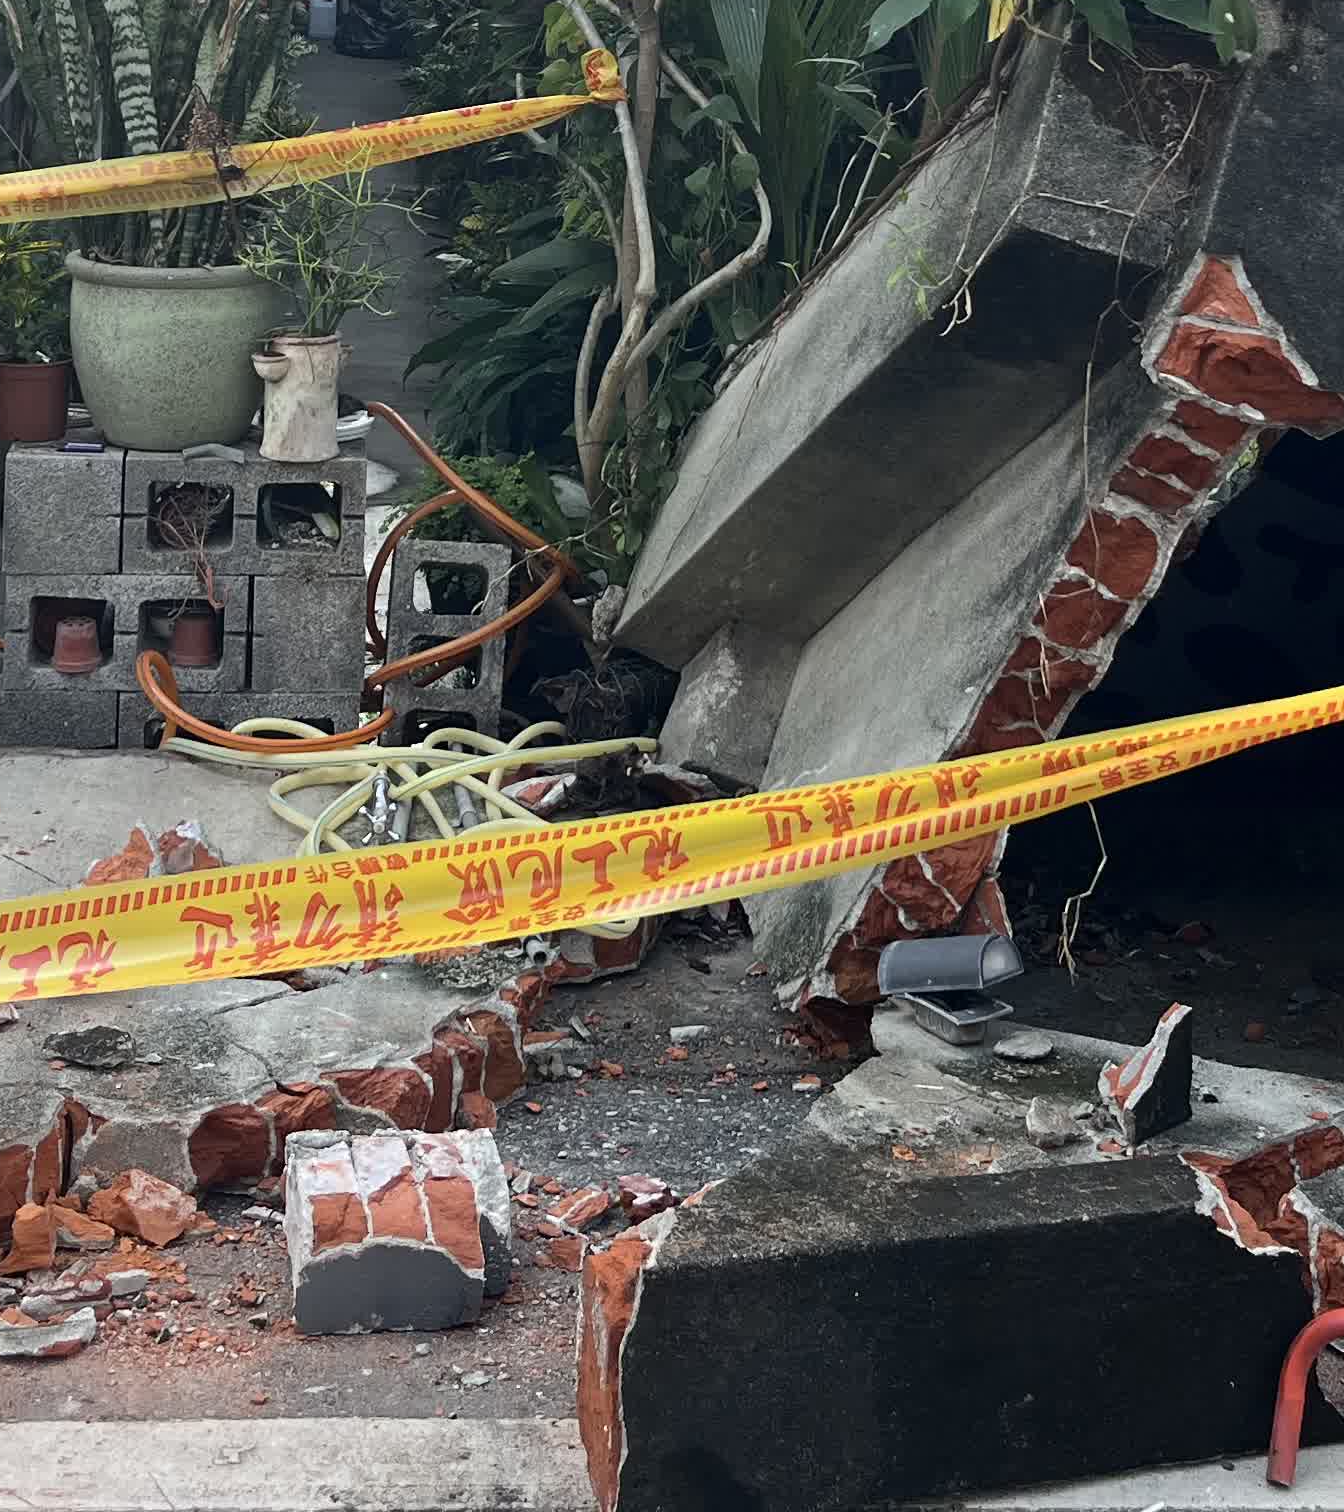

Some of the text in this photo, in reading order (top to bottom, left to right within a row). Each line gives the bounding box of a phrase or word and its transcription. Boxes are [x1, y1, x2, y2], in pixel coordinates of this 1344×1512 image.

[178, 873, 410, 975] 請勿靠近
[443, 828, 690, 926] 施工危險
